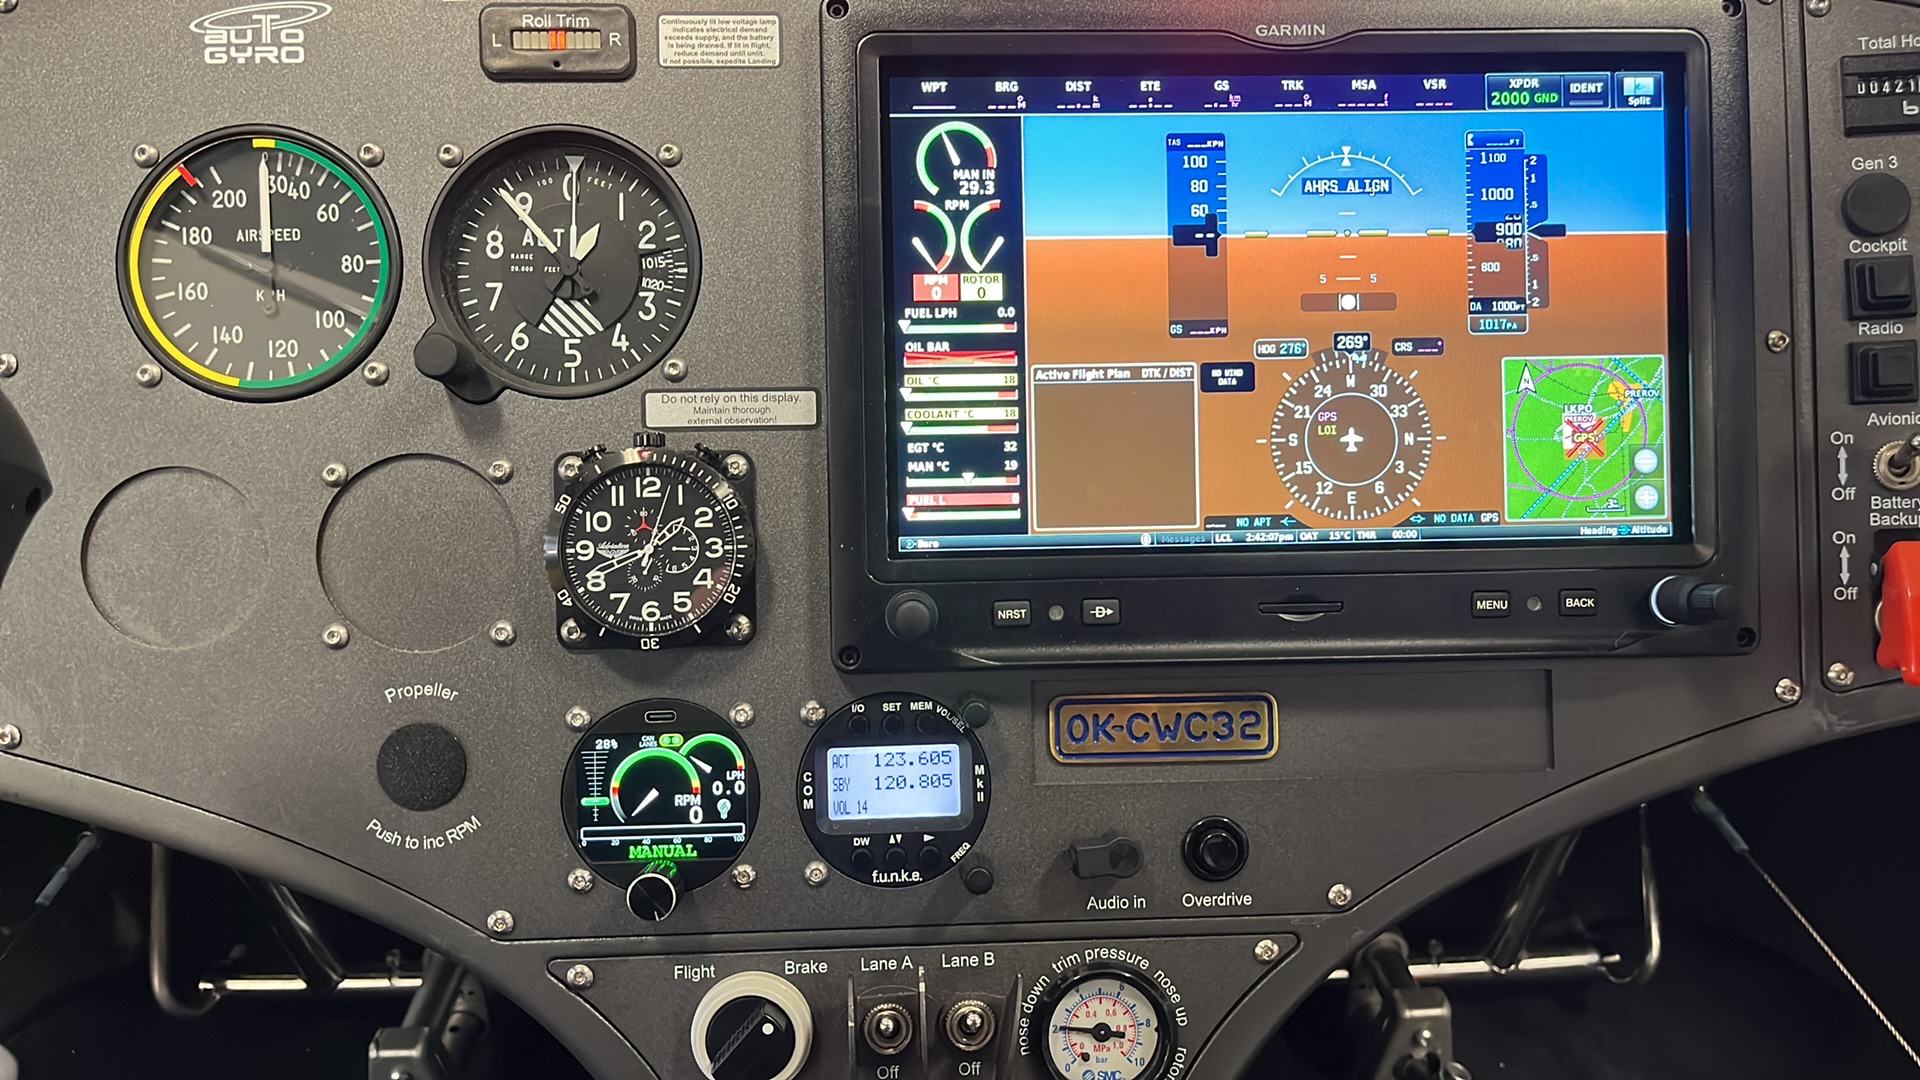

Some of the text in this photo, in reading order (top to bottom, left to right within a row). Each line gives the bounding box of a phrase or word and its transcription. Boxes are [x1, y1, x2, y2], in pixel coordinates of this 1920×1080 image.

[522, 14, 590, 28] Roll Trim
[661, 18, 707, 26] Continuously
[732, 18, 757, 26] voltage
[759, 18, 776, 26] lamp
[1255, 24, 1326, 37] GARMIN
[492, 33, 502, 47] L
[609, 33, 621, 47] R
[695, 34, 720, 42] supply,
[749, 34, 774, 42] battery
[1857, 34, 1896, 51] Total
[204, 47, 304, 64] GYRO
[682, 58, 714, 66] possible,
[716, 58, 746, 66] expedite
[747, 58, 776, 66] Landing
[920, 81, 948, 93] WPT
[994, 81, 1019, 93] BRG
[1065, 80, 1093, 92] DIST
[1140, 80, 1161, 92] ETE
[1213, 80, 1230, 92] GS
[1280, 79, 1304, 91] TRK
[1351, 79, 1377, 90] MSA
[1423, 78, 1447, 90] VSR
[1509, 78, 1540, 89] XPDR
[1569, 82, 1603, 94] IDENT
[1491, 91, 1559, 106] 2000 GND
[1627, 96, 1651, 107] Split
[1182, 155, 1208, 169] 100
[1480, 152, 1507, 165] 1100
[1851, 157, 1884, 171] Gen
[953, 168, 995, 180] MAN IN
[959, 180, 995, 196] 29.3
[1190, 180, 1209, 193] 80
[1304, 180, 1389, 194] AHRS ALIGN
[212, 190, 248, 209] 200
[1480, 188, 1514, 201] 1000
[944, 200, 970, 211] RPM
[316, 203, 340, 223] 60
[1495, 222, 1523, 236] 900
[182, 226, 212, 246] 180
[1849, 238, 1908, 255] Cockpit
[340, 254, 364, 274] 80
[1480, 261, 1500, 273] 800
[923, 274, 949, 286] RPM
[963, 275, 999, 284] ROTOR
[178, 282, 208, 301] 160
[904, 306, 1016, 319] FUEL LPH 0.0
[315, 310, 345, 330] 100
[212, 326, 243, 345] 140
[1858, 322, 1904, 336] Radio
[268, 340, 298, 358] 120
[904, 341, 950, 353] OIL BAR
[1257, 344, 1276, 354] HDG
[1394, 342, 1413, 352] CRS
[906, 376, 924, 386] OIL
[1035, 367, 1193, 382] Active Flight Plan DTK DIST
[661, 393, 802, 406] Do not rely on this display.
[1624, 389, 1660, 398] PREROV
[693, 406, 771, 416] Maintain thorough
[907, 410, 959, 419] COOLANT
[1564, 404, 1593, 413] LKPO
[687, 416, 777, 425] external observation!
[1317, 411, 1337, 422] GPS
[1317, 425, 1337, 436] LOI
[1573, 433, 1595, 442] GPS
[1830, 431, 1854, 445] On
[907, 442, 929, 454] EGT
[907, 461, 934, 473] MAN
[1831, 487, 1856, 500] Off
[1236, 517, 1272, 528] NO APT
[1433, 512, 1500, 523] NO DATA GPS
[1869, 512, 1920, 528] Backu
[1161, 529, 1418, 545] Messages 2:42:07pm 00:00
[1579, 525, 1668, 536] Heading Altitude
[1832, 531, 1856, 545] On
[1833, 587, 1858, 601] Off
[1476, 600, 1508, 610] MENU
[1565, 598, 1595, 608] BACK
[997, 609, 1027, 620] NRST
[384, 682, 459, 703] Propeller
[851, 704, 865, 713] I/O
[882, 703, 901, 712] SET
[910, 701, 933, 711] MEM
[935, 704, 967, 734] VOL/SEL
[1066, 710, 1262, 745] OK-CWC32
[832, 750, 953, 769] ACT 123.605
[726, 770, 745, 780] LPH
[712, 780, 746, 795] 0.0
[832, 773, 953, 792] SBY 120.805
[803, 772, 814, 810] COM
[674, 794, 701, 807] RPM
[832, 800, 868, 815] VOL 14
[689, 806, 703, 824] 0
[365, 814, 482, 850] Push to inc RPM
[853, 837, 870, 847] DW
[628, 844, 698, 859] MANUAL
[950, 841, 971, 863] FREQ
[871, 869, 923, 884] f.u.n.k.e.
[1086, 894, 1147, 910] Audio in
[1182, 892, 1253, 908] Overdrive
[860, 955, 914, 972] Lane A
[942, 952, 995, 968] Lane B
[1051, 947, 1150, 974] trim pressure
[674, 964, 716, 982] Flight
[784, 960, 828, 976] Brake
[1153, 969, 1189, 1027] nose up
[1018, 974, 1050, 1056] nose down
[1093, 1044, 1111, 1053] MPa
[1095, 1056, 1108, 1064] bar
[876, 1065, 900, 1080] Off
[958, 1061, 981, 1076] Off
